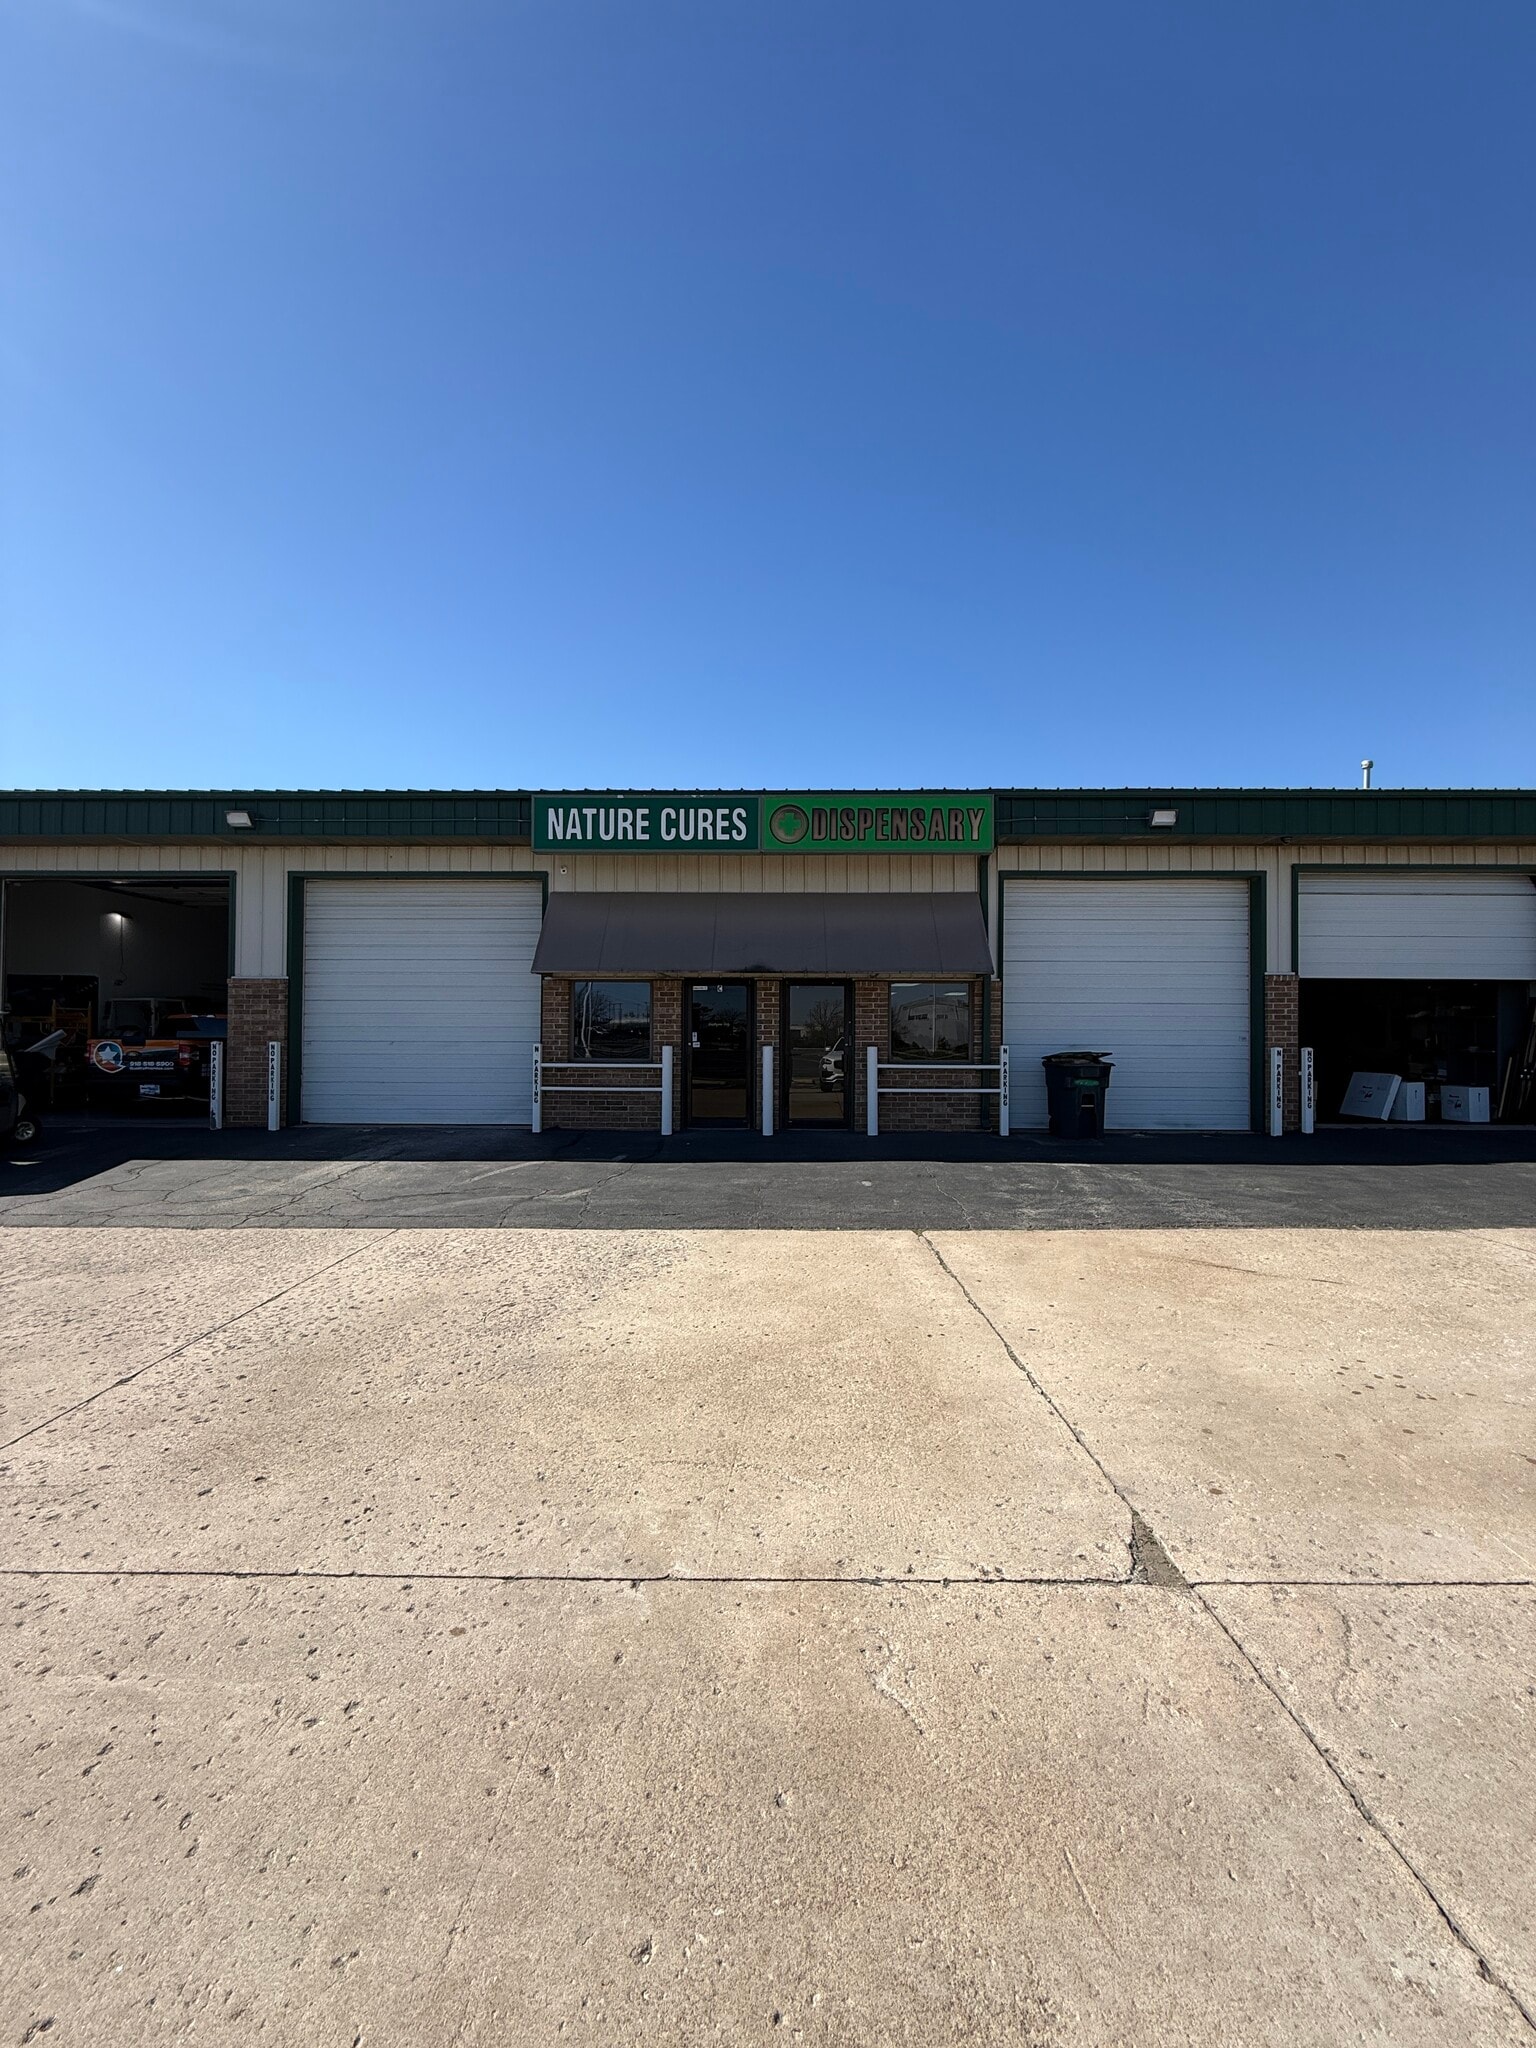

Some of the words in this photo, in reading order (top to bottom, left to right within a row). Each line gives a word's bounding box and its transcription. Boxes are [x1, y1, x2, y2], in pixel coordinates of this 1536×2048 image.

[547, 807, 650, 841] NATURE
[660, 807, 748, 842] CURES
[811, 808, 985, 841] DISPENSARY
[211, 1044, 217, 1056] NO
[270, 1044, 276, 1056] NO
[1307, 1050, 1313, 1063] NO
